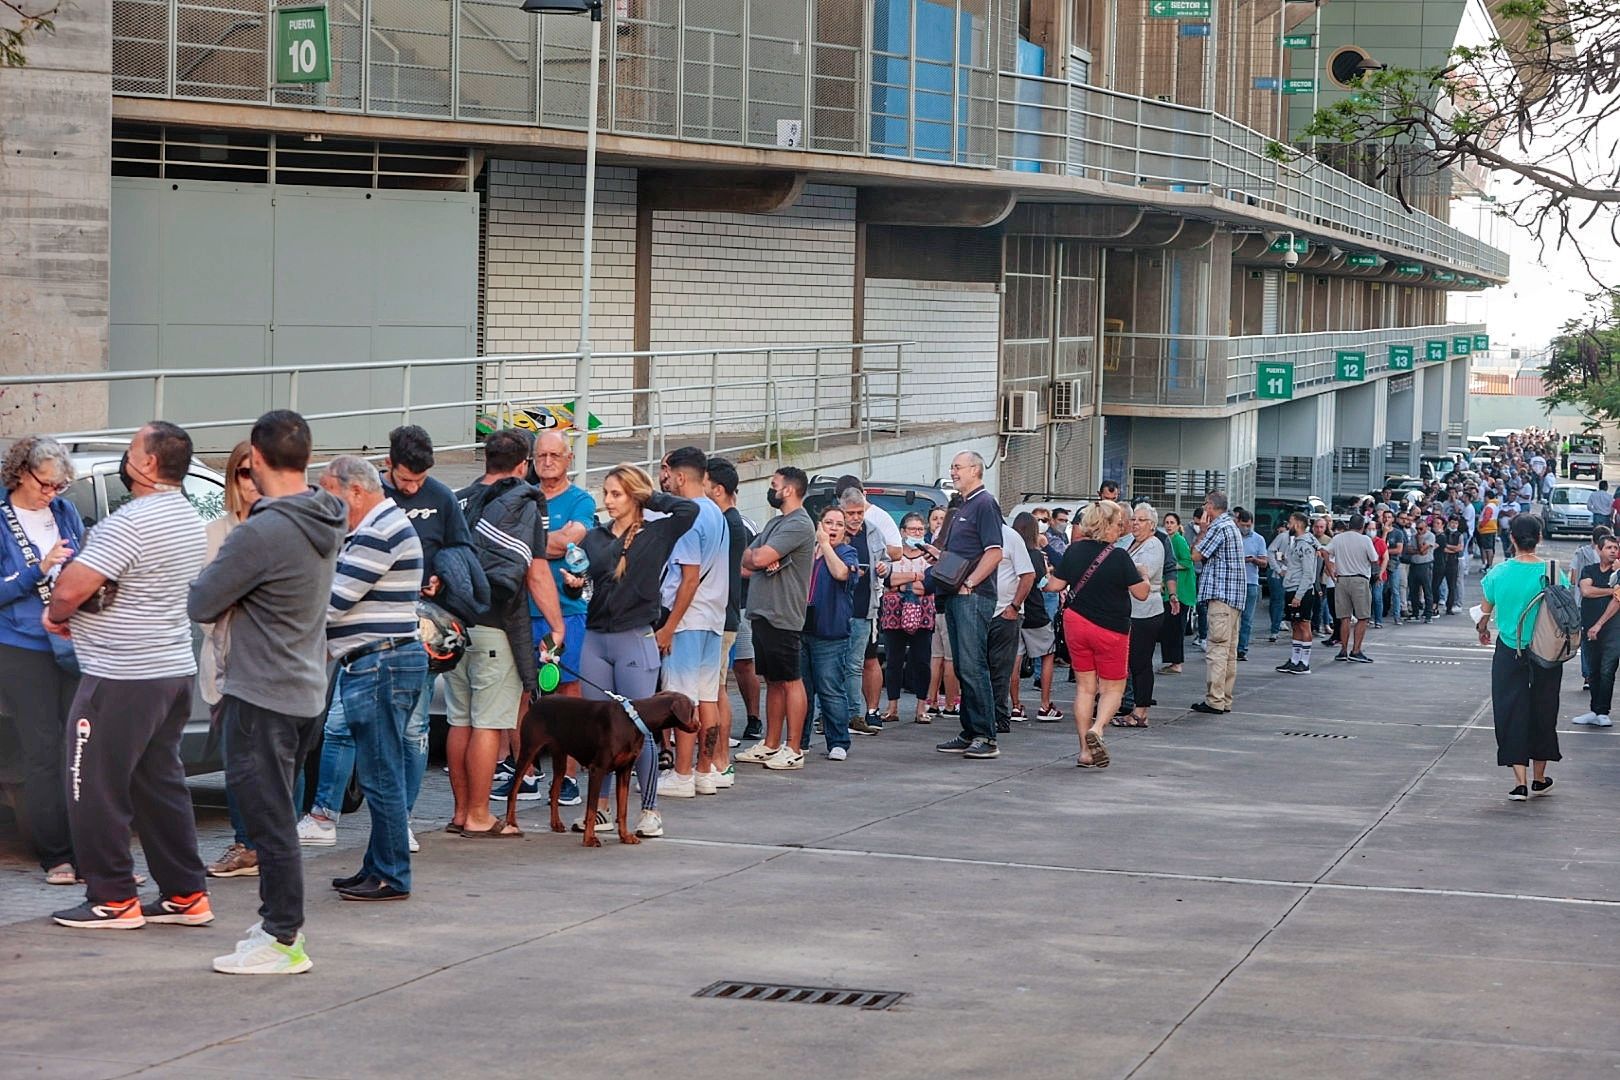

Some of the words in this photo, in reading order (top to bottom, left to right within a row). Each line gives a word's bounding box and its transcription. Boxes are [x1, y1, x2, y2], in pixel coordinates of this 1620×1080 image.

[289, 18, 316, 30] PUERTA
[288, 39, 317, 73] 10
[1430, 349, 1442, 360] 14
[1457, 344, 1467, 353] 15
[1395, 356, 1408, 367] 13
[1343, 364, 1359, 377] 12
[1267, 378, 1283, 394] 11
[7, 519, 30, 547] LIFE'S
[70, 718, 91, 801] Champion
